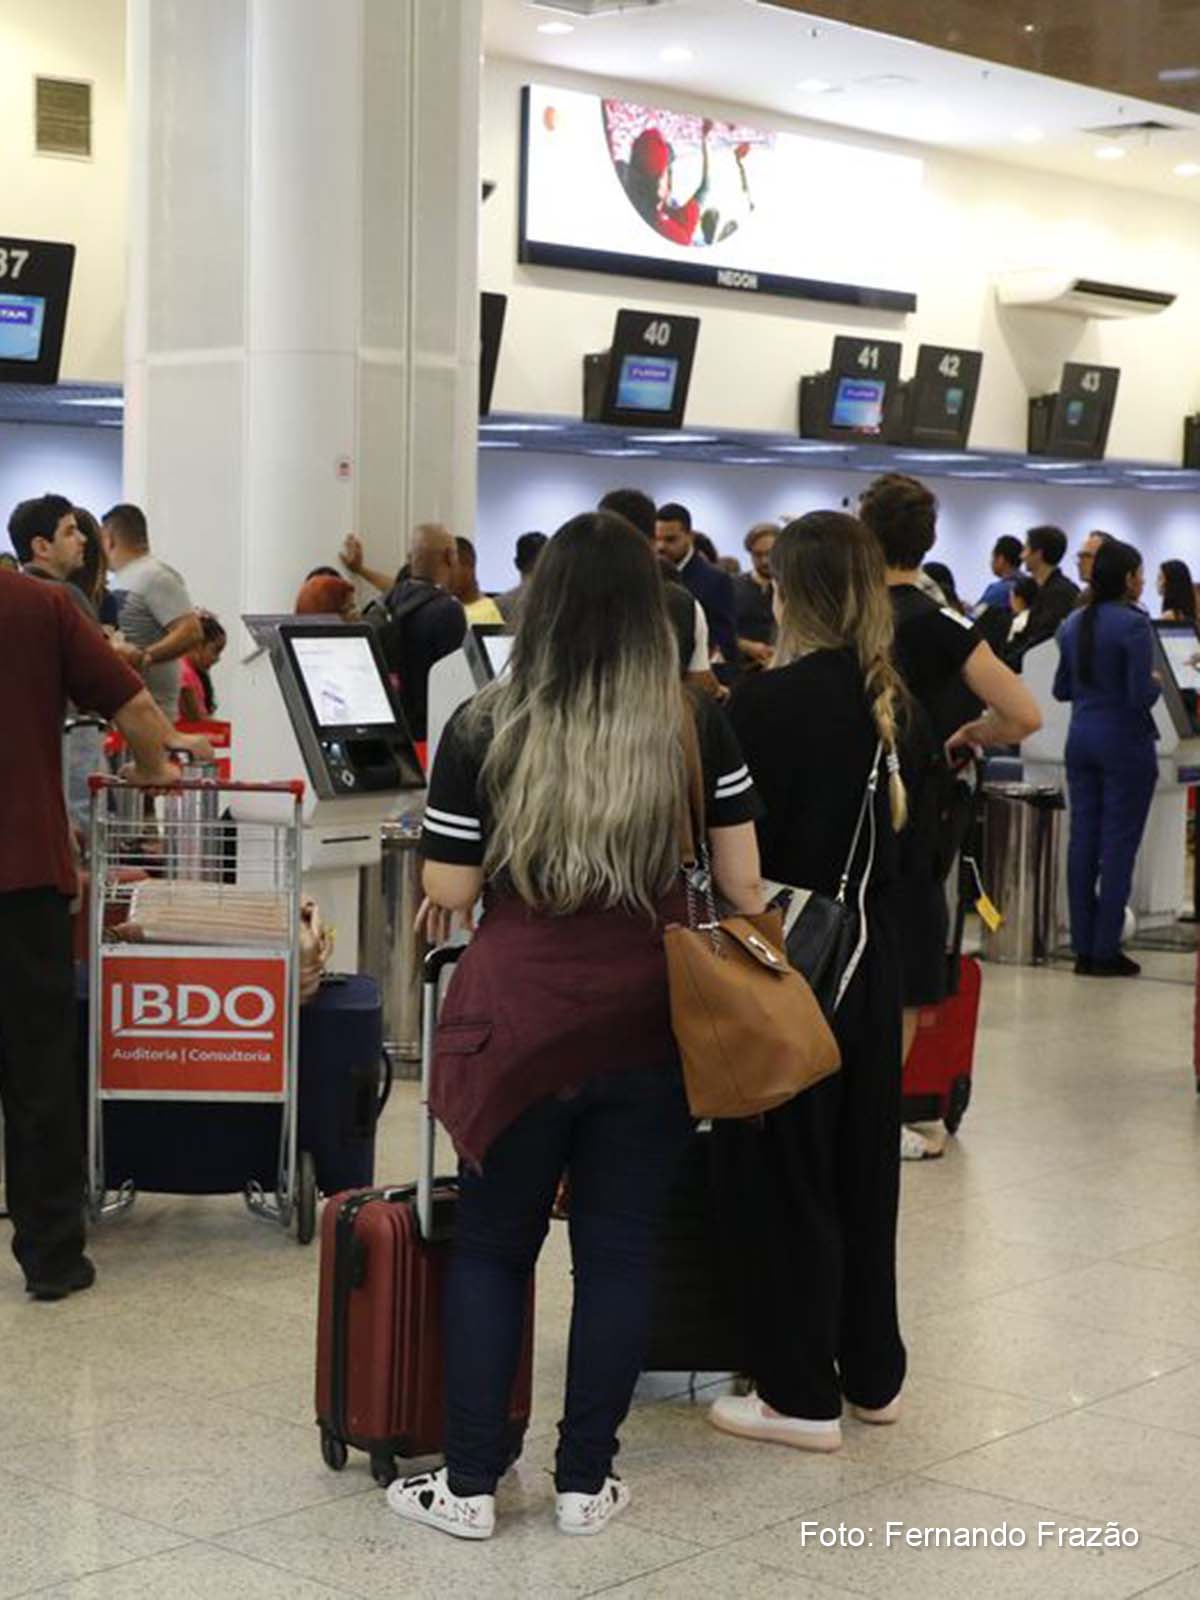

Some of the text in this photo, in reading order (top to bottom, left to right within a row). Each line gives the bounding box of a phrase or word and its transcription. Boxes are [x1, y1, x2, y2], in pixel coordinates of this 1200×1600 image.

[643, 321, 672, 346] 40
[857, 345, 880, 370] 41
[938, 354, 961, 378] 42
[132, 983, 276, 1028] BDO
[112, 1047, 272, 1063] Auditoria Consultoria
